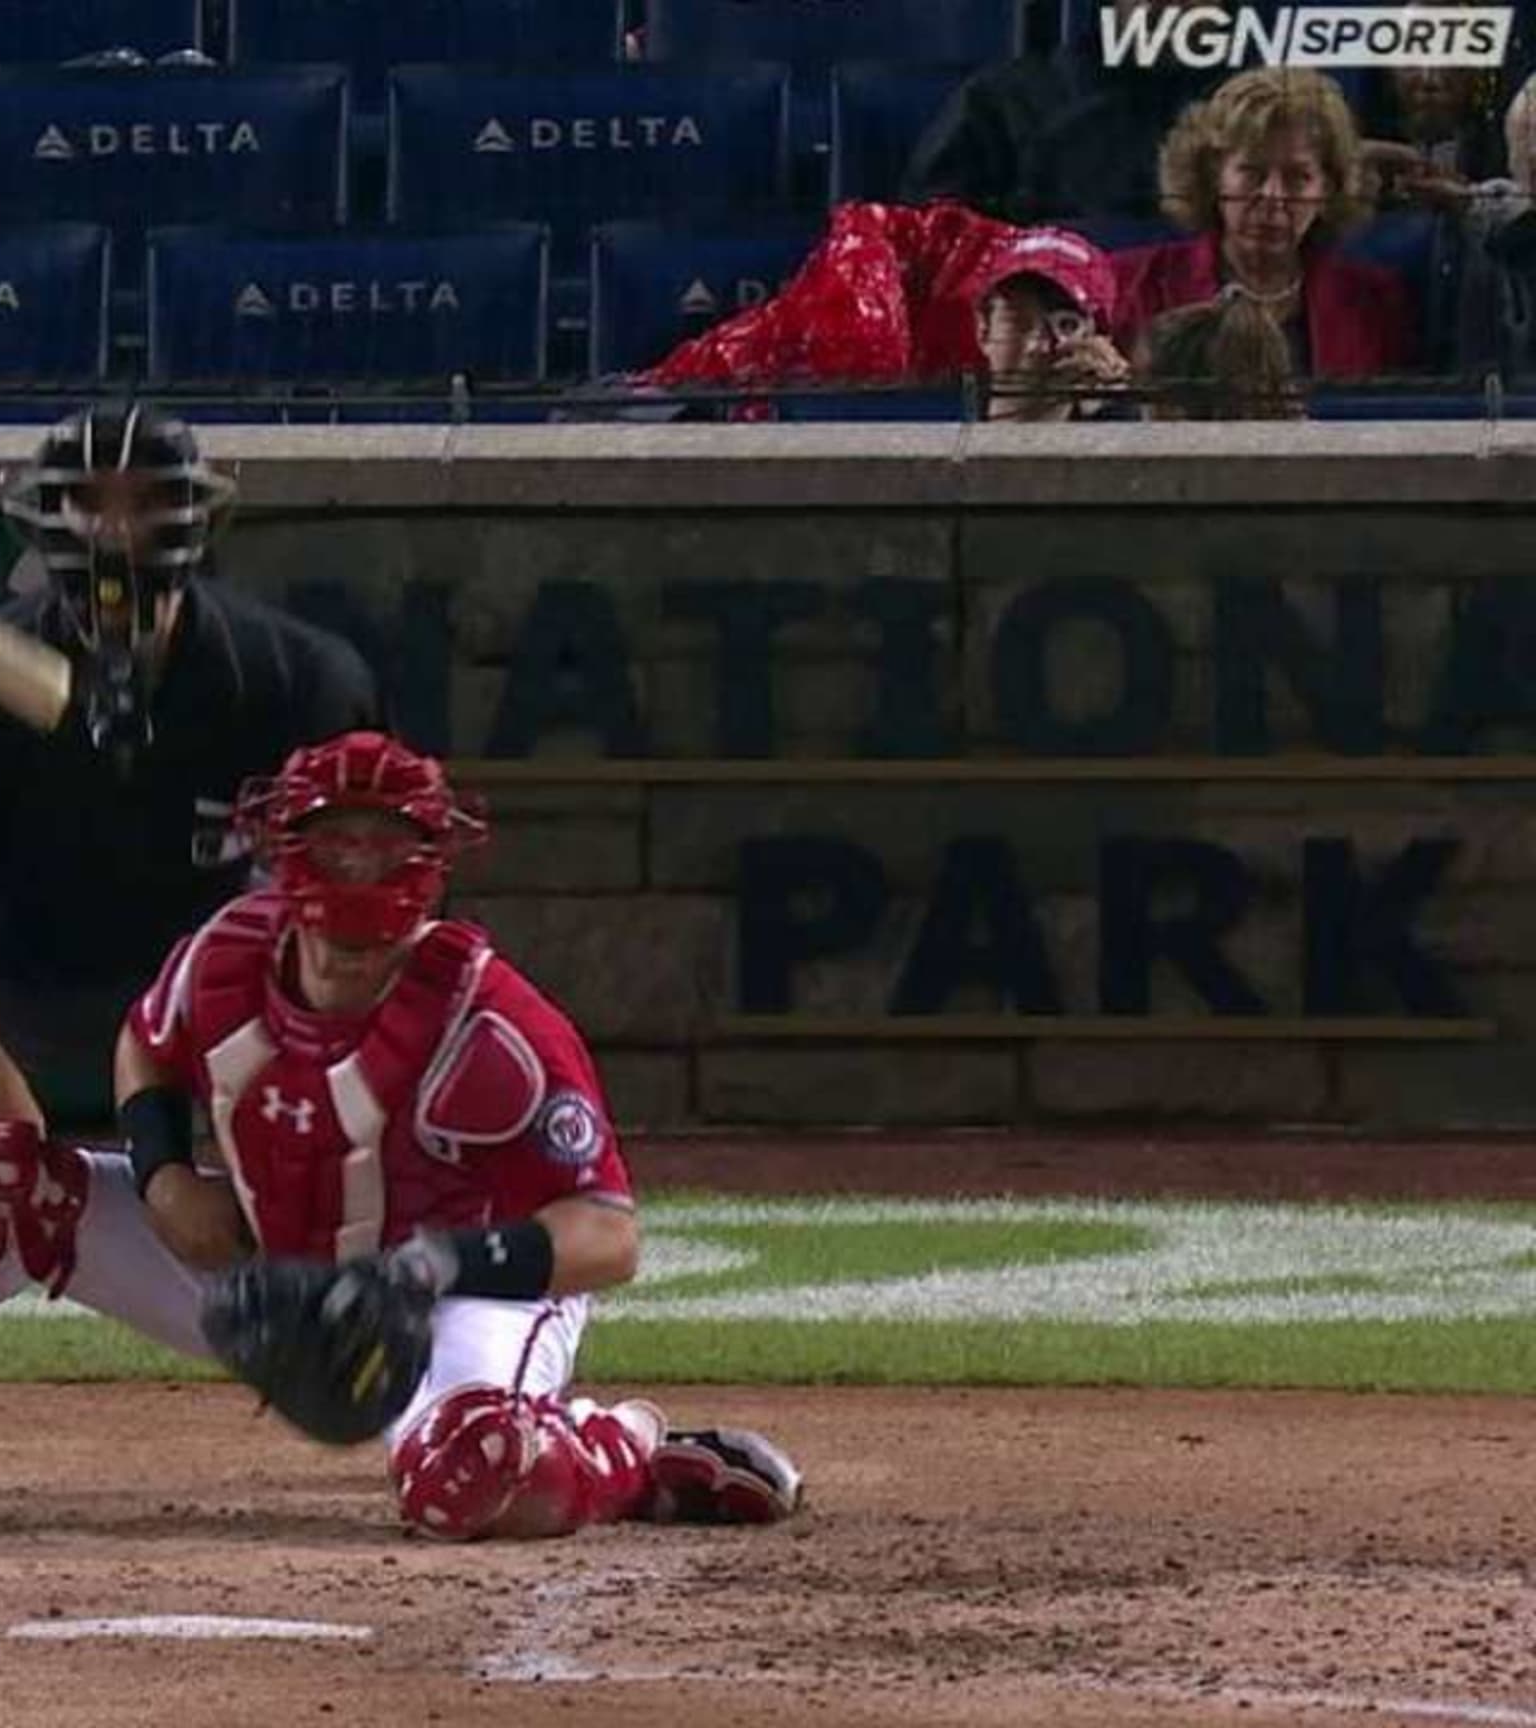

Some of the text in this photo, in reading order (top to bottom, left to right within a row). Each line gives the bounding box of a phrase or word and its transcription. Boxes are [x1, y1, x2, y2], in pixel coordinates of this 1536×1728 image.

[89, 121, 260, 155] DELTA
[530, 116, 703, 149] DELTA
[290, 281, 461, 313] DELTA
[738, 836, 1471, 1017] PARK
